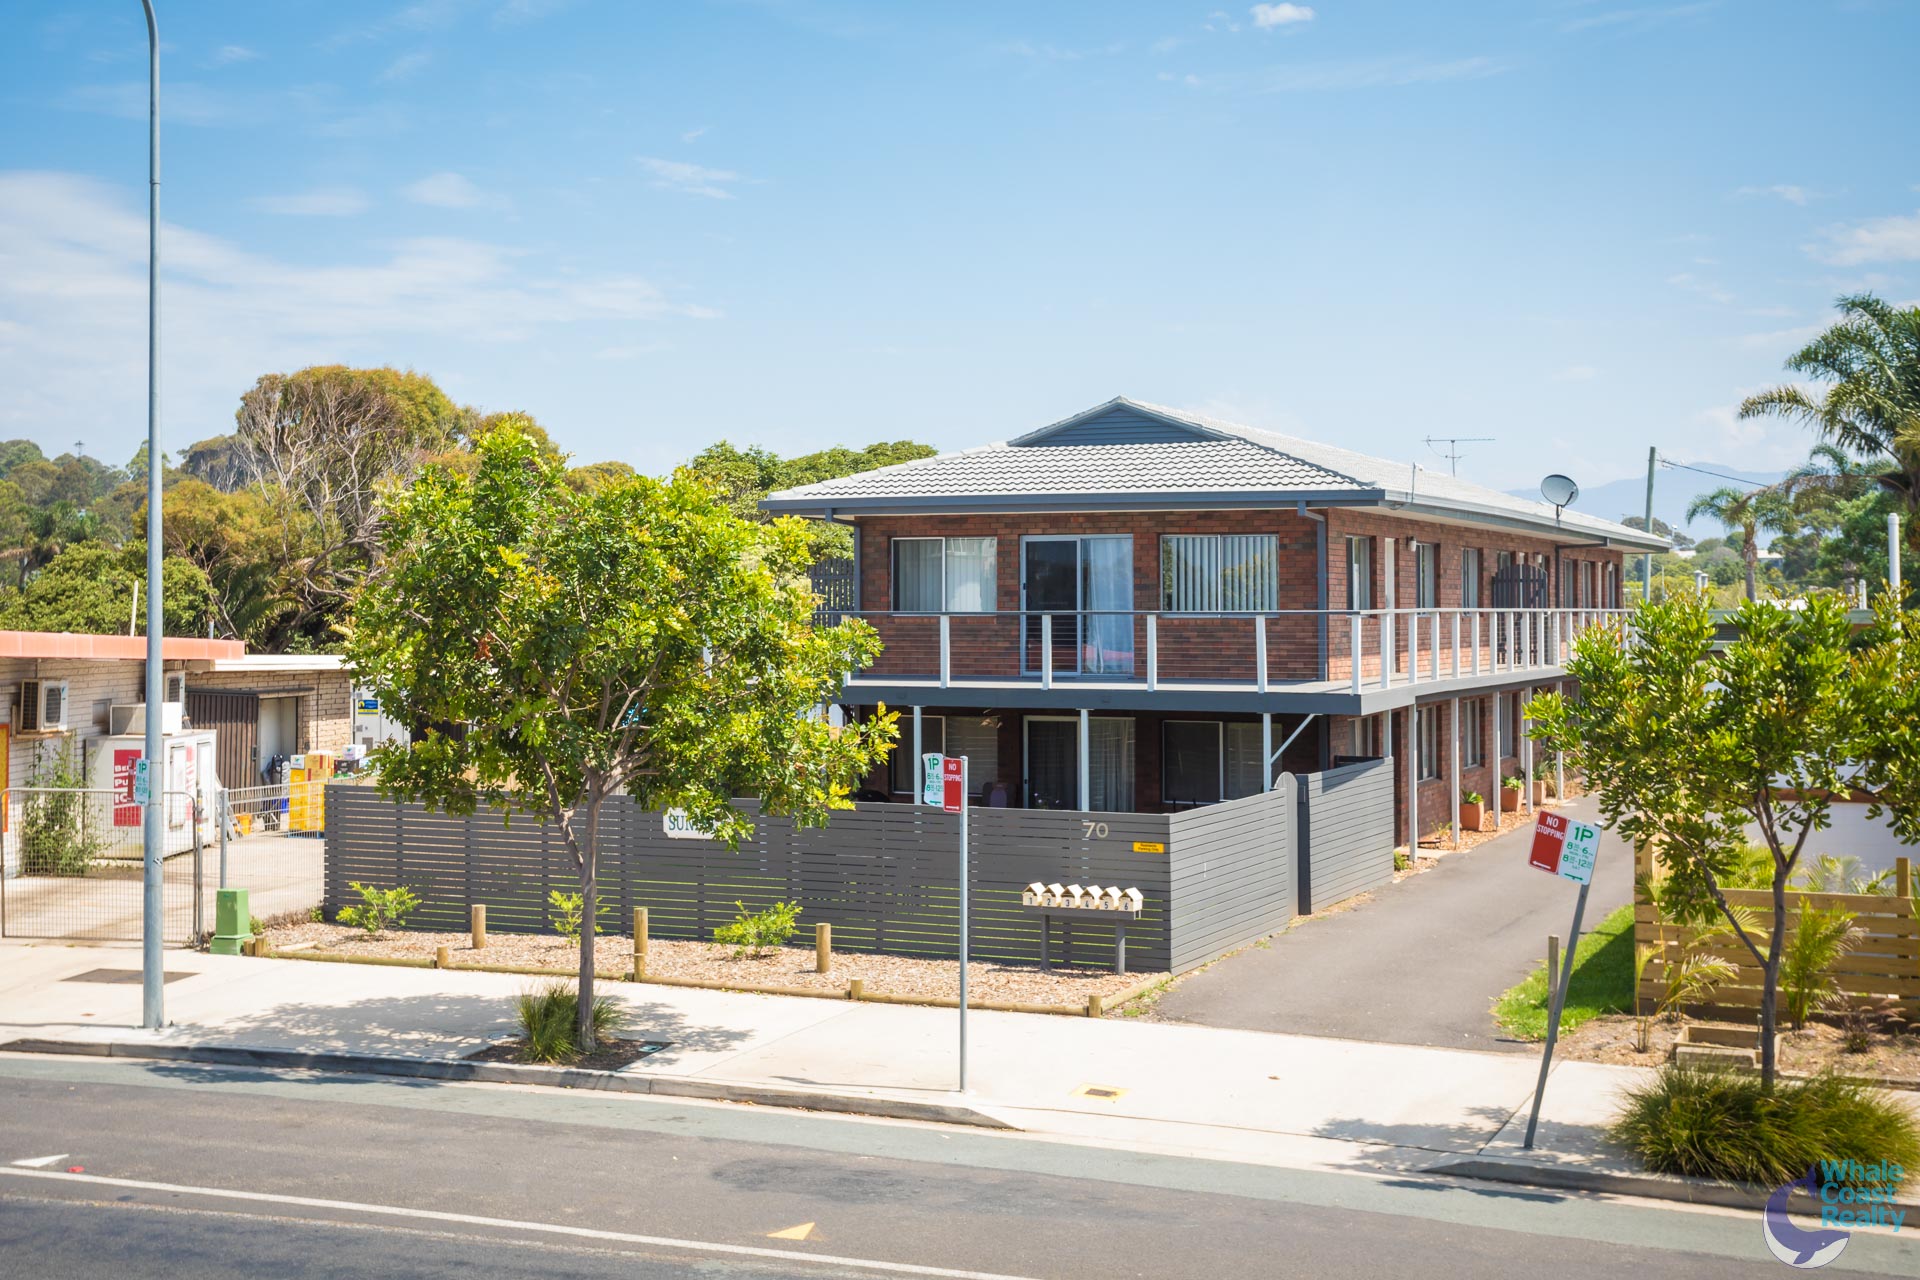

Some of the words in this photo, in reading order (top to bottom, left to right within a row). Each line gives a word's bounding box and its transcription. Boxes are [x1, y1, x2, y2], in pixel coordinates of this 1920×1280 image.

[138, 763, 147, 774] 1P
[928, 758, 939, 770] 1P
[114, 794, 131, 804] IC
[1546, 816, 1559, 828] NO
[1082, 822, 1109, 838] 70
[1536, 824, 1565, 840] STOPPING
[1574, 826, 1594, 842] 1P
[1029, 897, 1033, 905] 1
[1047, 898, 1051, 906] 2
[1065, 899, 1070, 907] 3
[1084, 900, 1089, 908] 4
[1104, 901, 1109, 909] 5
[1124, 903, 1129, 911] 6
